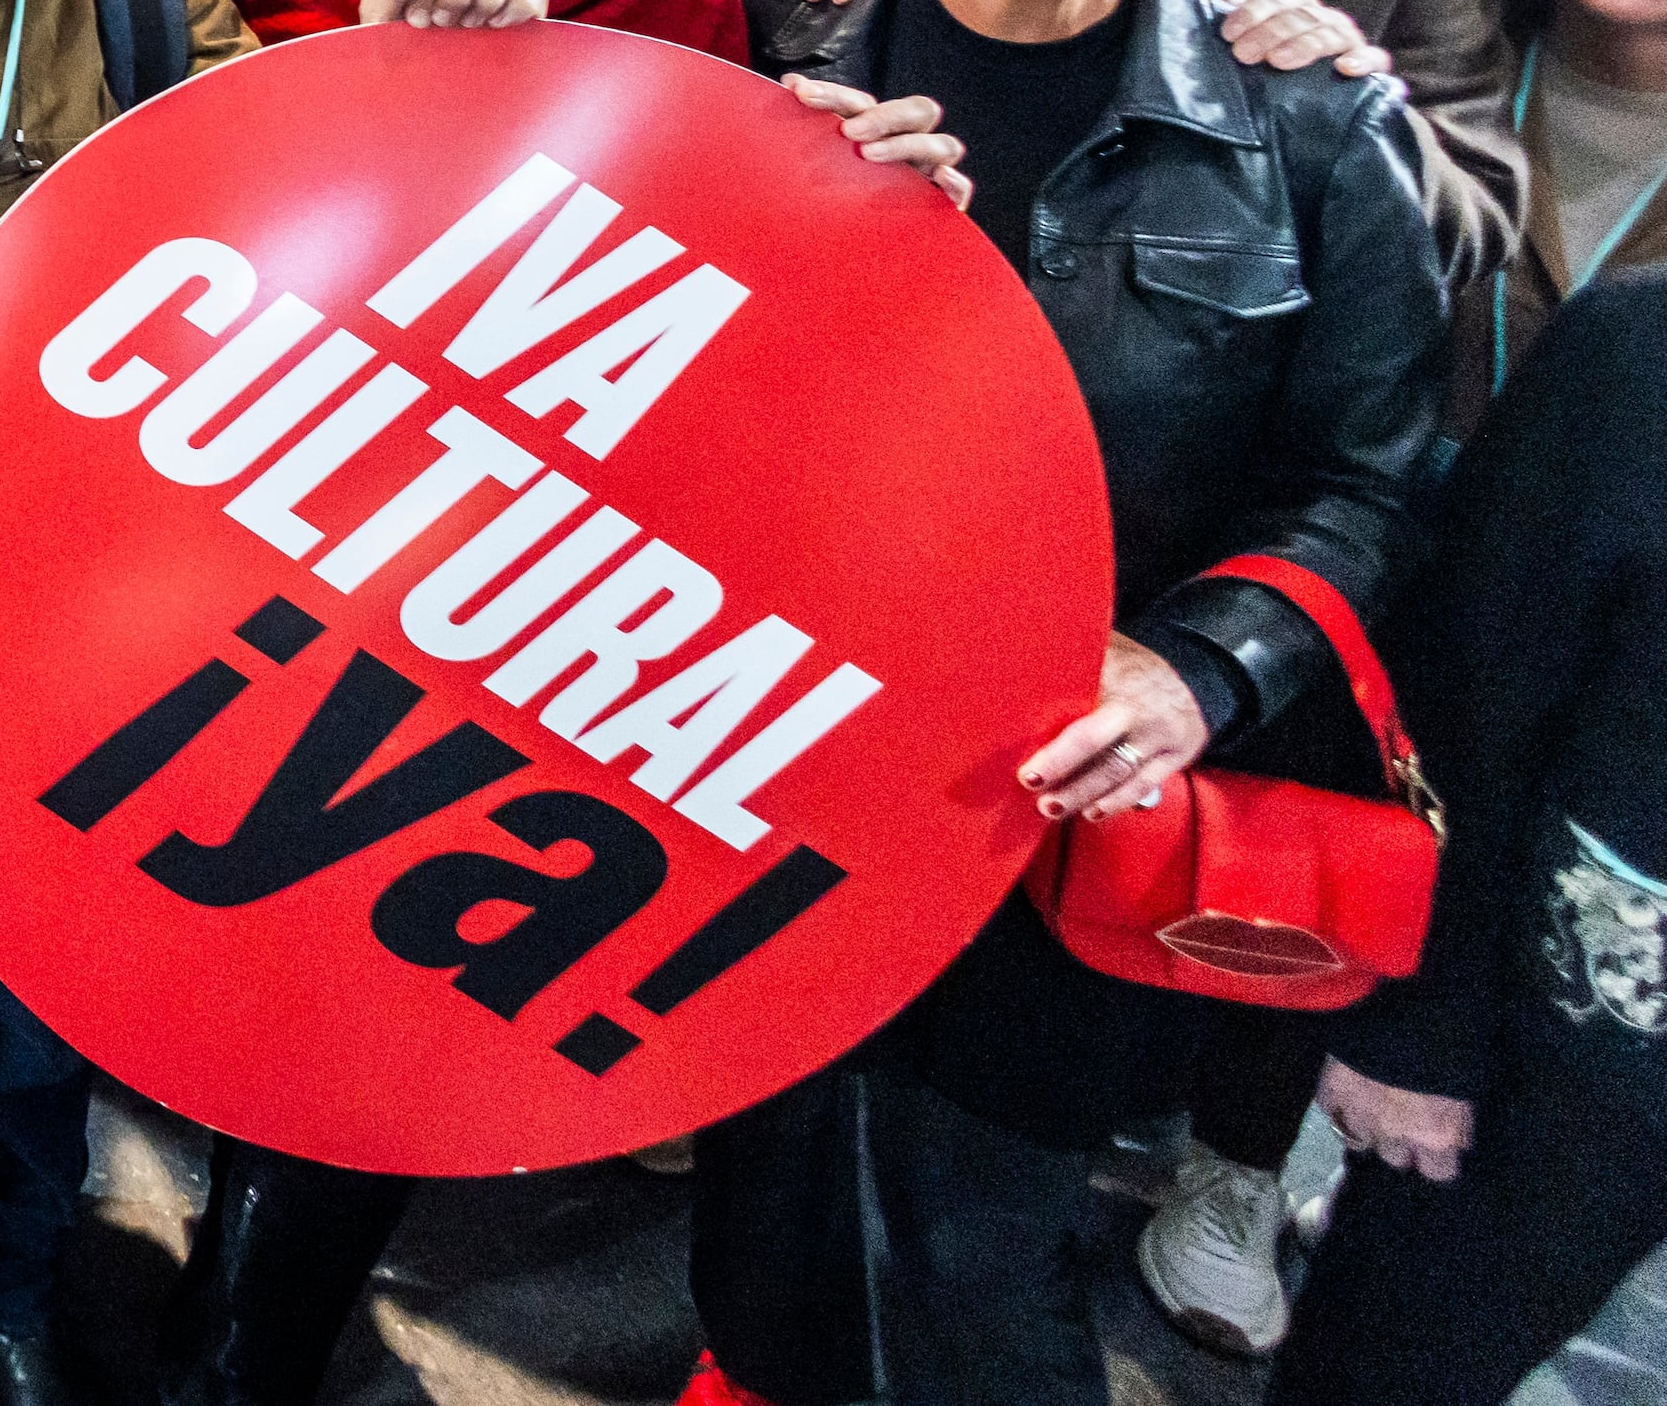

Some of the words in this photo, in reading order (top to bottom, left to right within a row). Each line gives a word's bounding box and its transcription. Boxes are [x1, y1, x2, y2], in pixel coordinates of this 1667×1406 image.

[38, 236, 884, 851] CULTURAL
[366, 152, 752, 463] IVA
[36, 594, 851, 1078] ¡ya!
